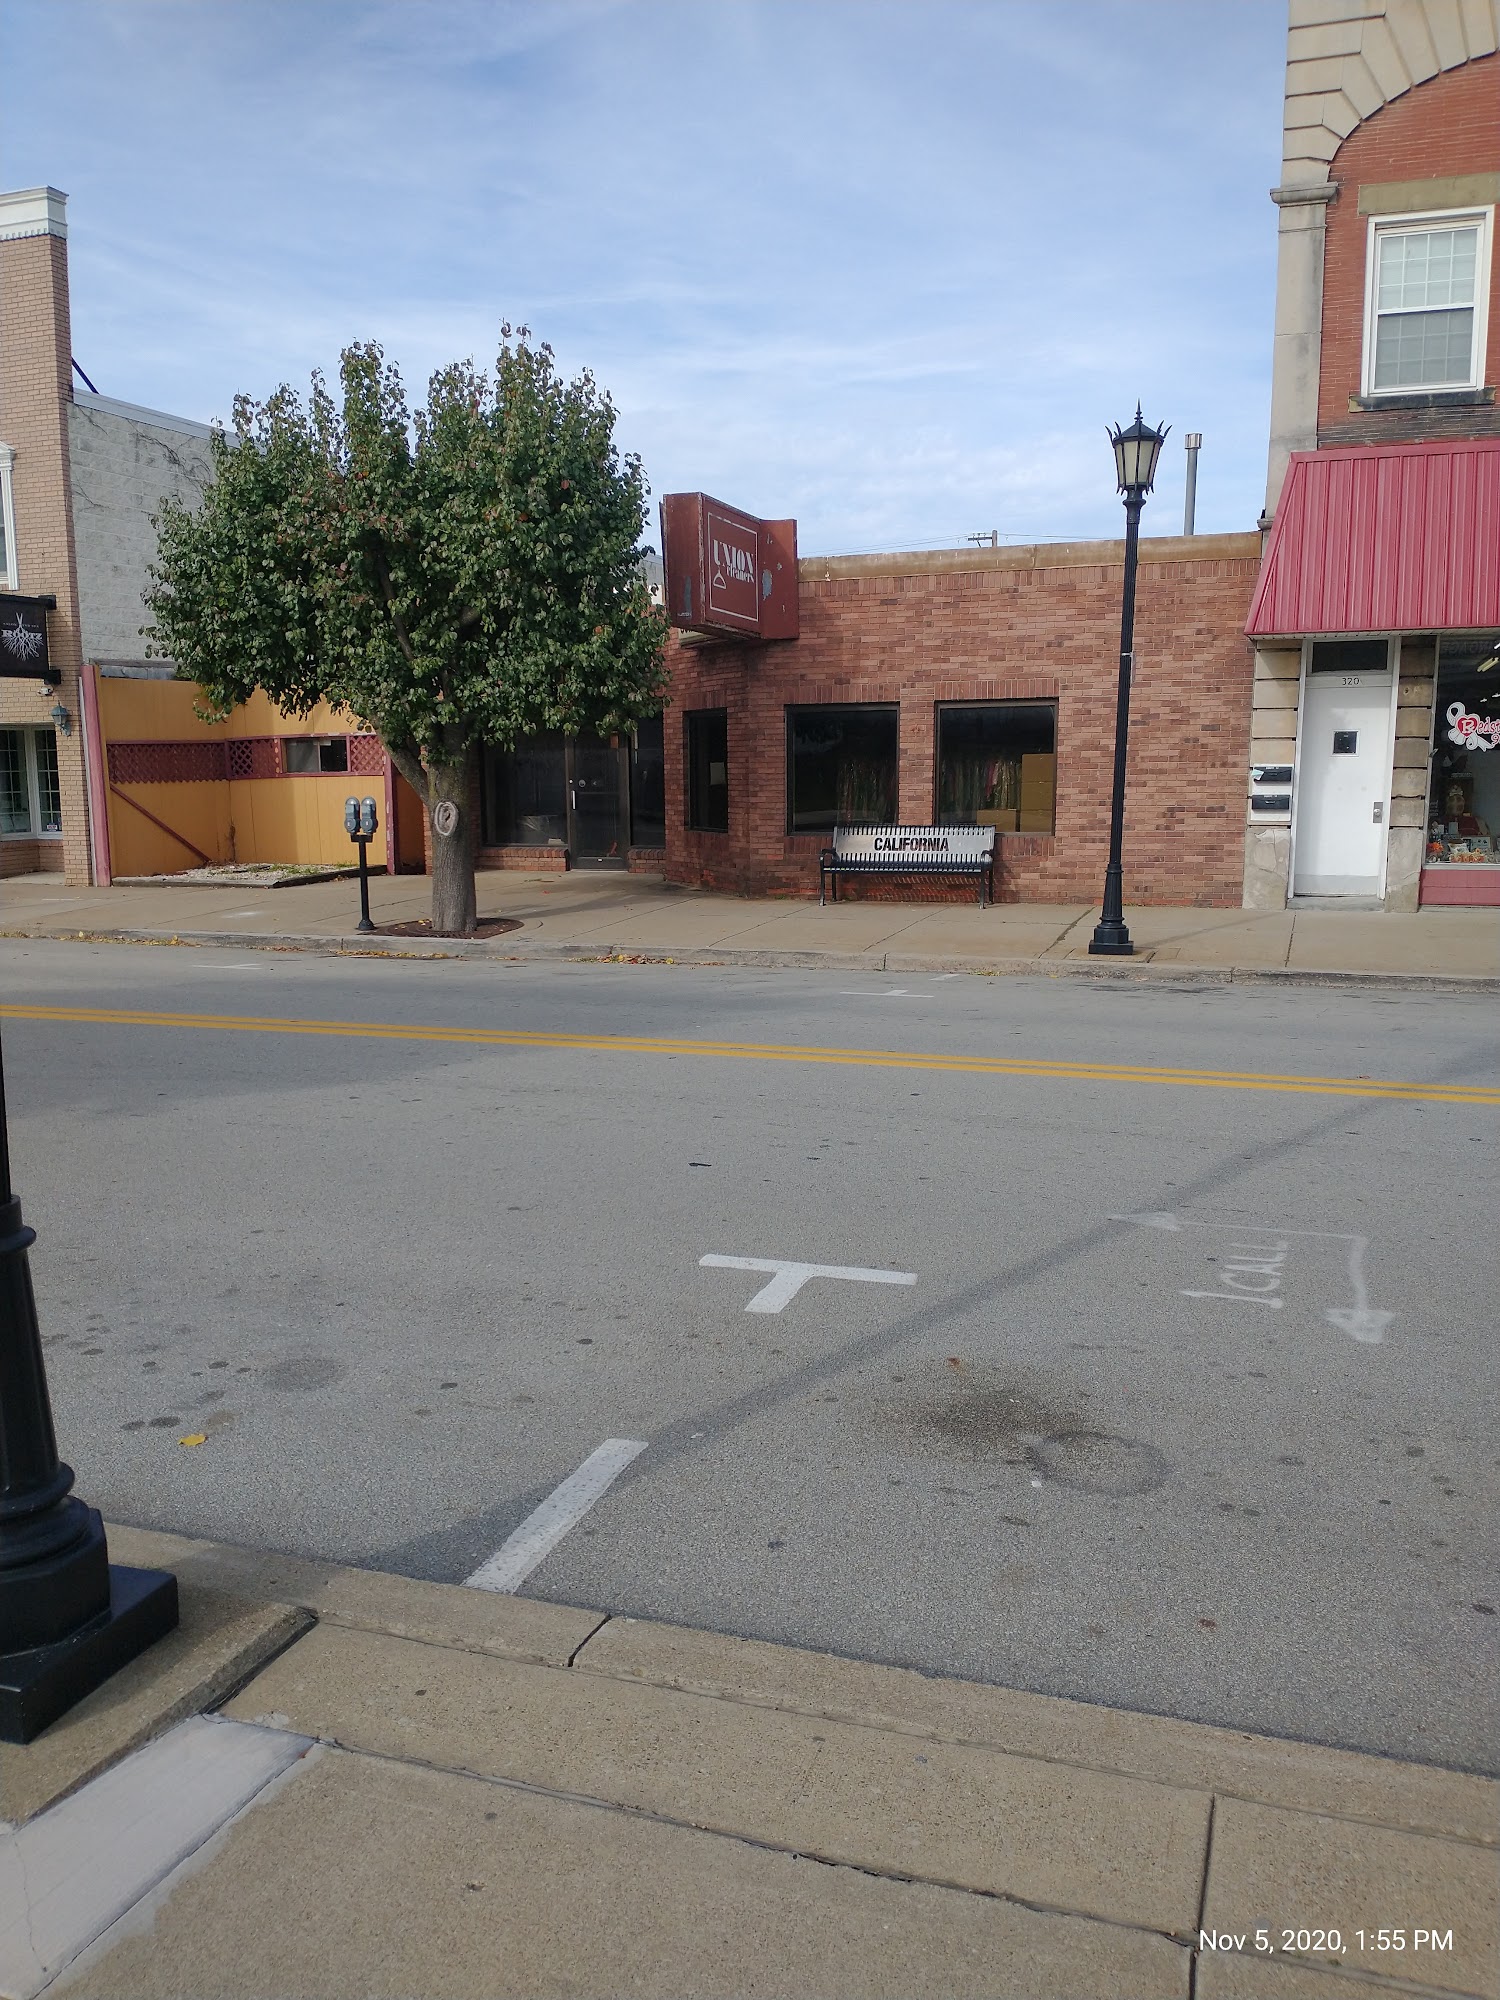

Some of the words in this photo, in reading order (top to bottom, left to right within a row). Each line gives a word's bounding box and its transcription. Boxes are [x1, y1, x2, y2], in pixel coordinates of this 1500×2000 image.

[713, 539, 754, 575] UNION
[726, 563, 755, 583] cleaners
[1, 629, 42, 640] ROOTZ
[1342, 677, 1360, 686] 320
[874, 837, 949, 852] CALIFORNIA
